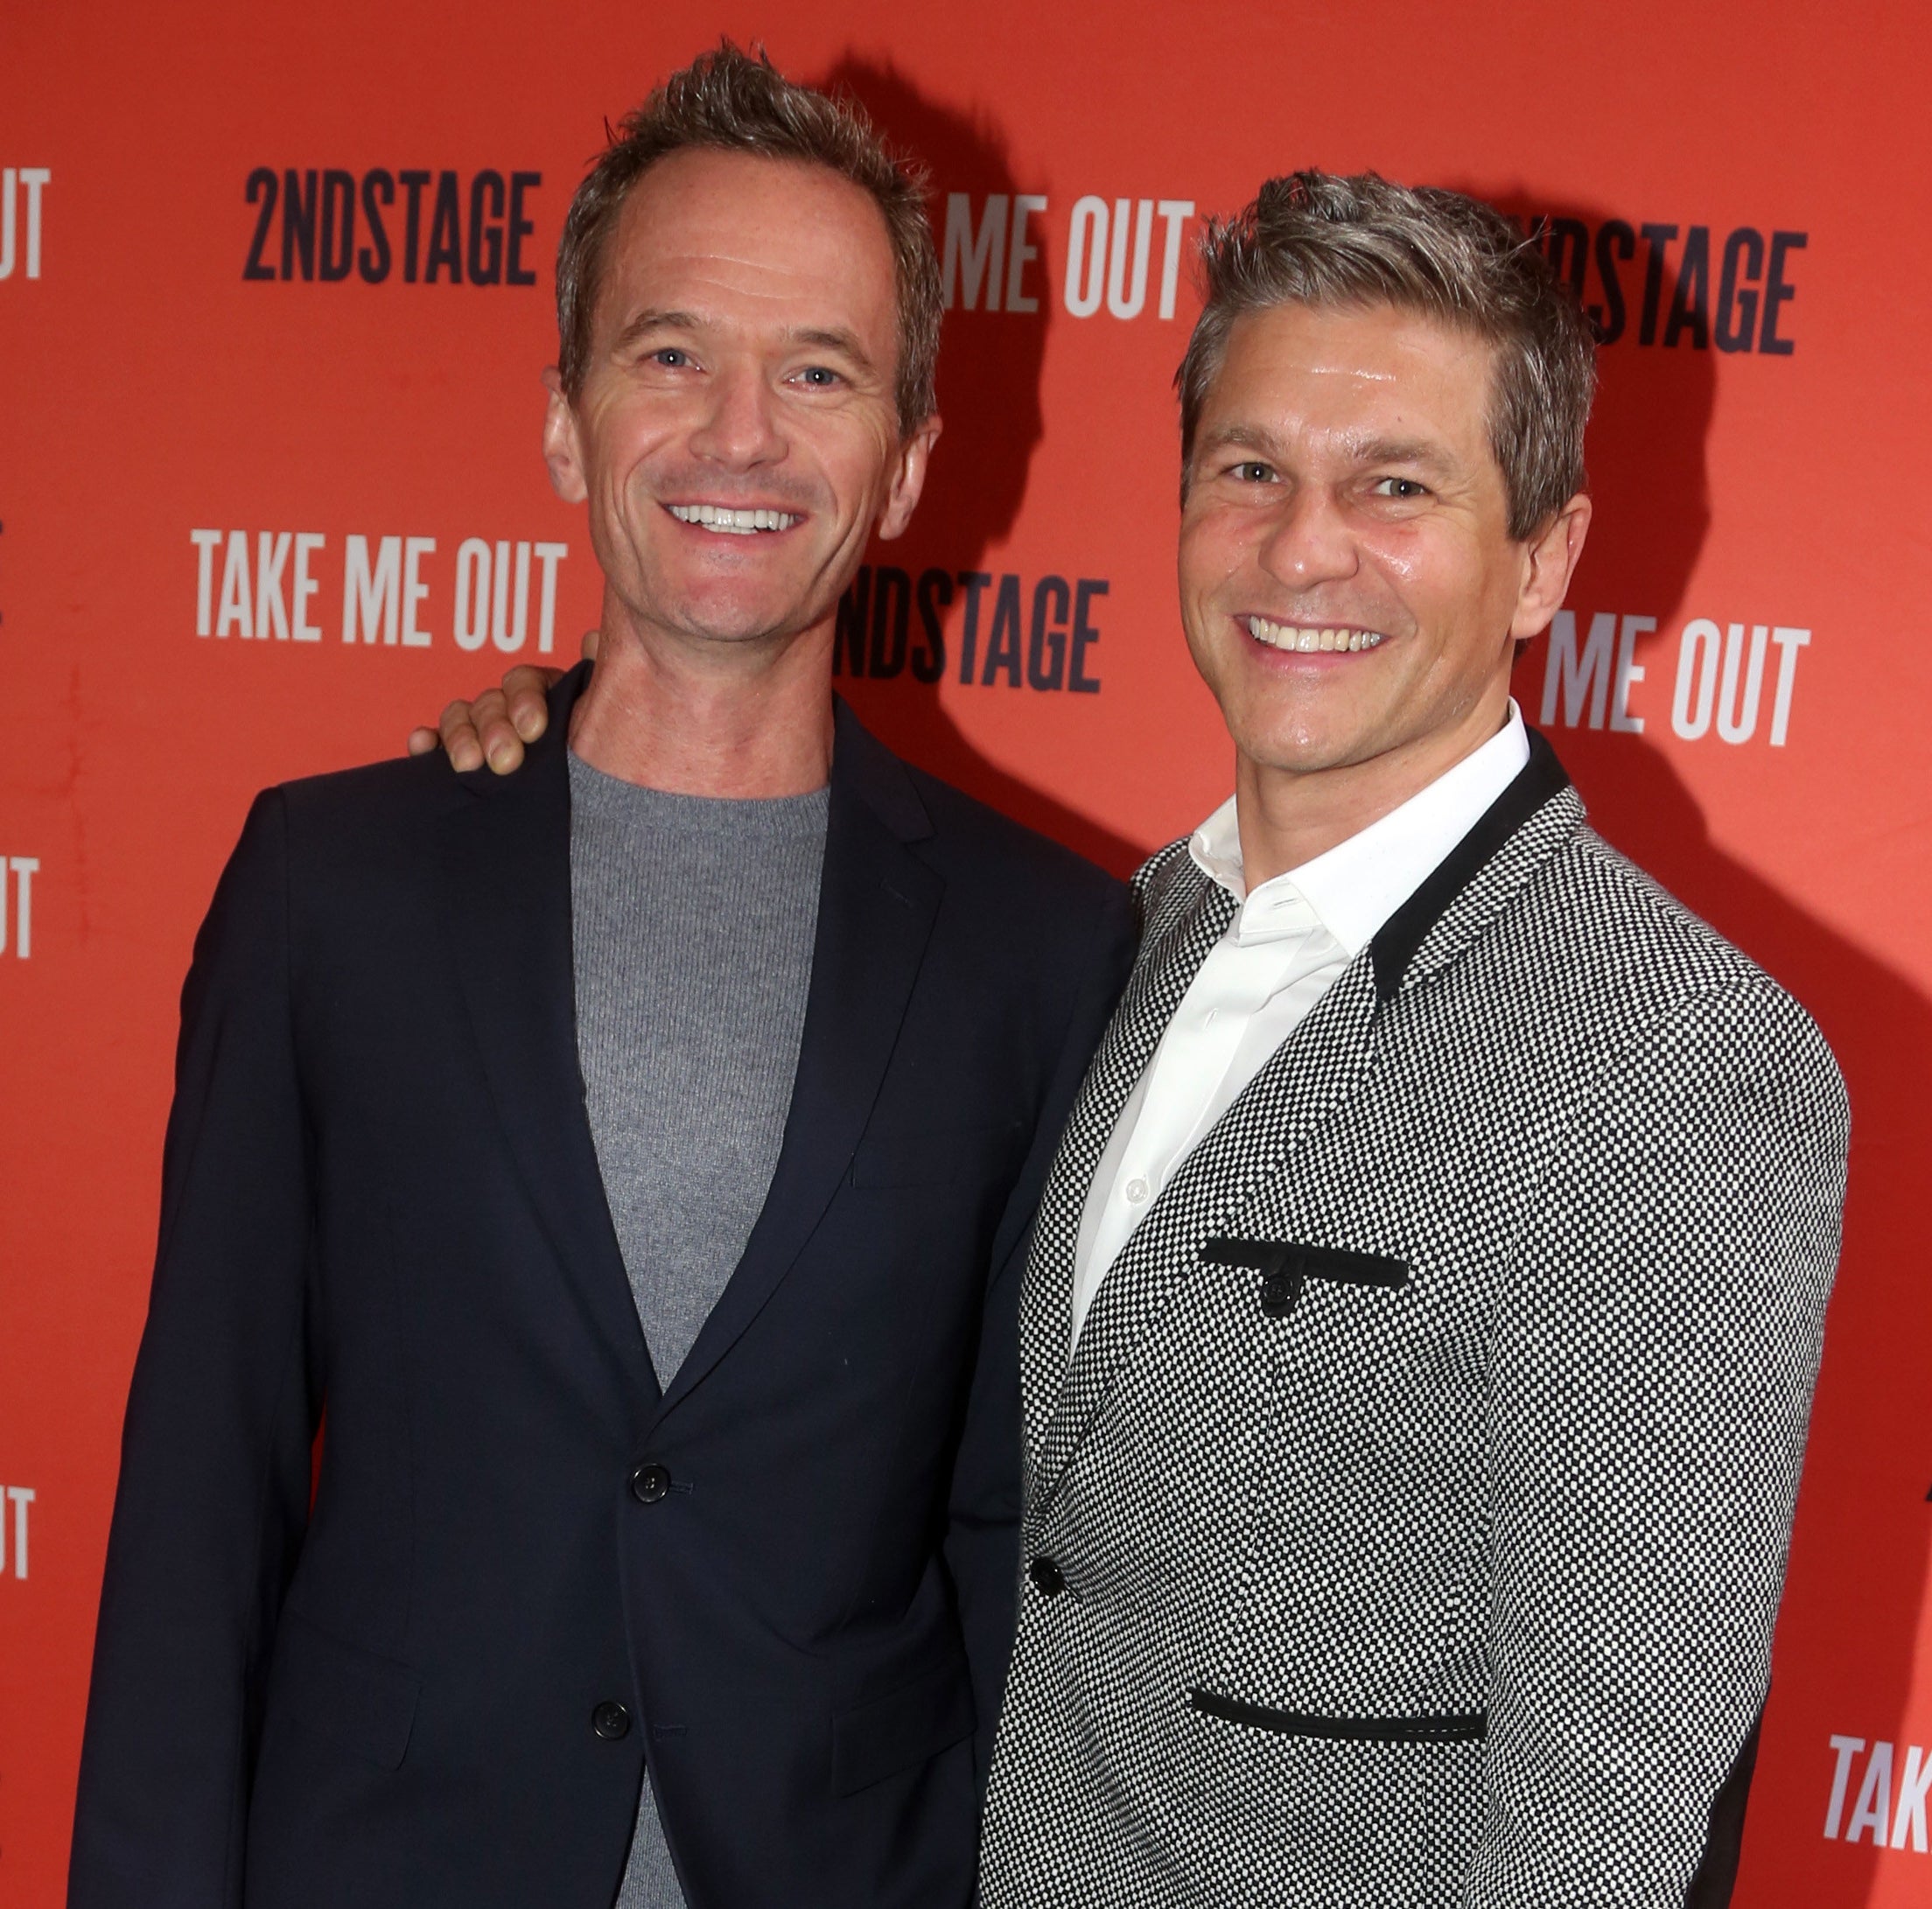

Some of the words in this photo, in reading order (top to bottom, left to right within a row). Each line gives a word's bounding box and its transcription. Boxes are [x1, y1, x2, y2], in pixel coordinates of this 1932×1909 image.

[242, 167, 542, 287] 2NDSTAGE
[942, 192, 1047, 313] ME
[1063, 194, 1195, 320] OUT
[1521, 216, 1809, 356] DSTAGE
[191, 529, 326, 642] TAKE
[342, 535, 436, 647] ME
[453, 537, 568, 653] OUT
[1539, 609, 1657, 735] ME
[1670, 618, 1812, 747] OUT
[1823, 1734, 1932, 1855] TAK
